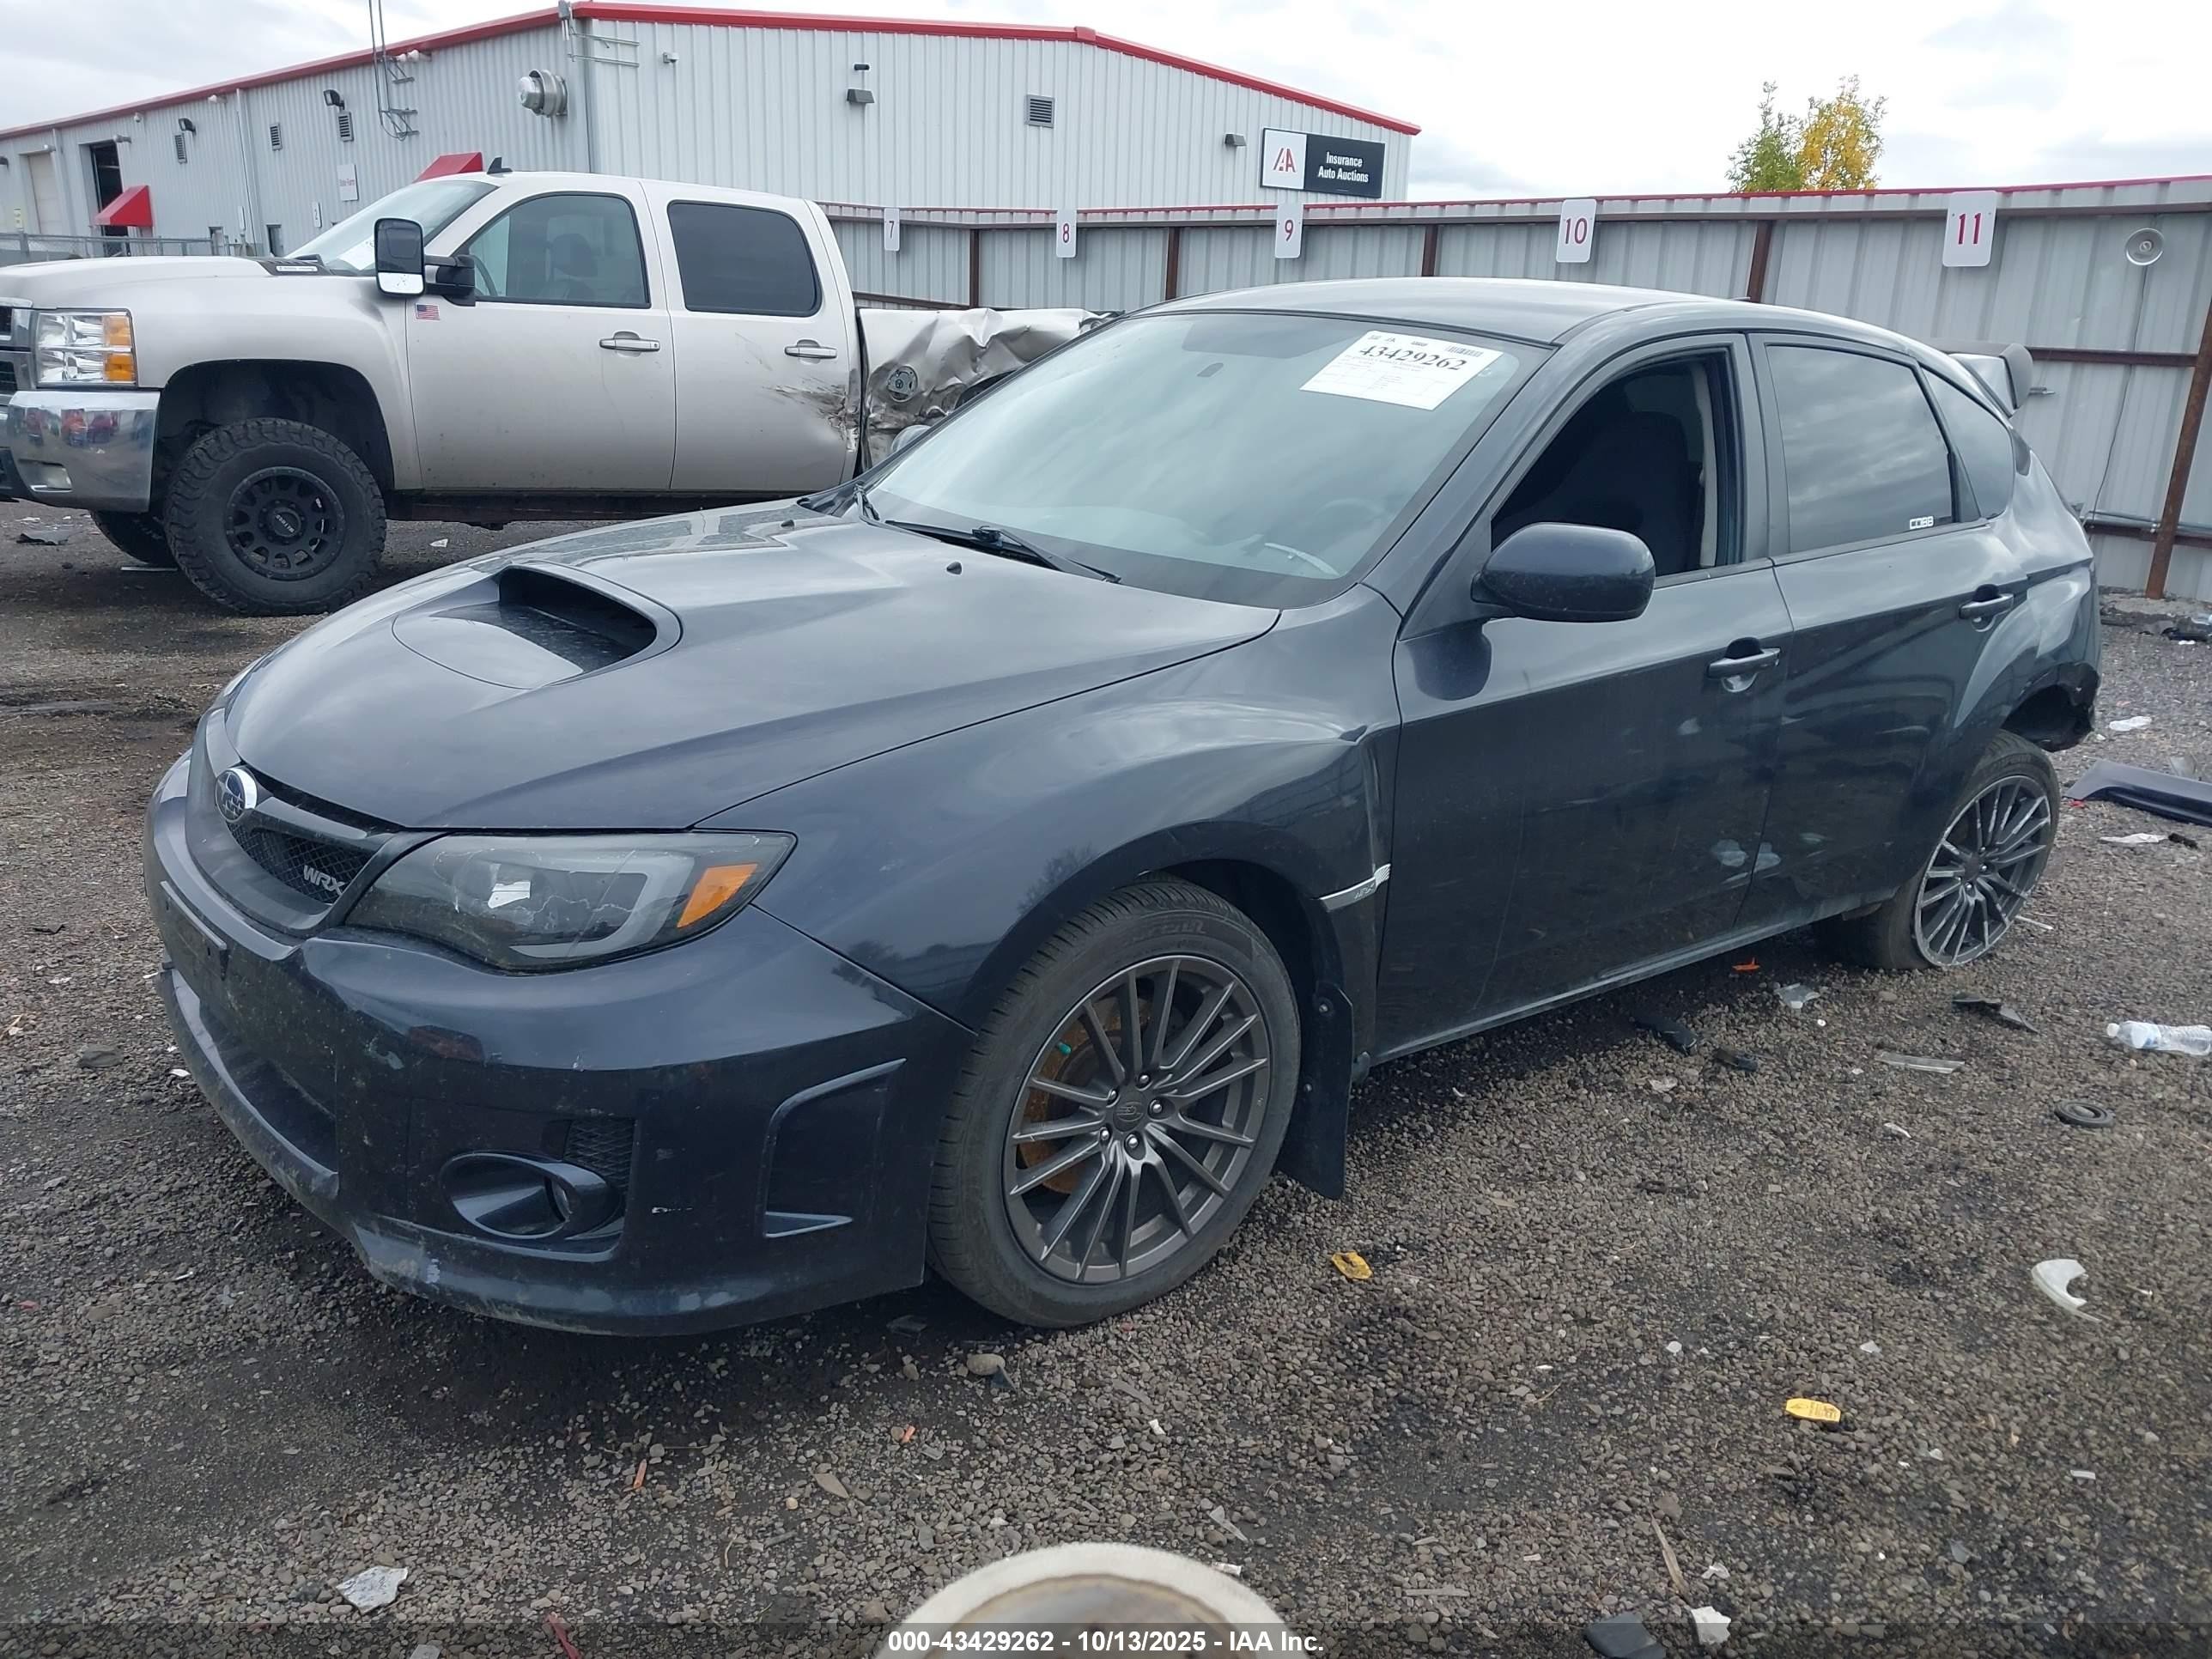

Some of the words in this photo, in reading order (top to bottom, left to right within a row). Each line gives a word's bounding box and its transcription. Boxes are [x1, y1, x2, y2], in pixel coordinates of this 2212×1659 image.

[1326, 151, 1363, 167] Insurance
[1317, 165, 1336, 179] Auto
[1336, 167, 1369, 183] Auctions
[888, 220, 895, 239] 7
[1062, 222, 1070, 244] 8
[1285, 219, 1294, 241] 9
[1564, 217, 1588, 245] 10
[1957, 213, 1982, 245] 11
[1359, 345, 1468, 371] 43429262
[303, 865, 345, 896] WRX
